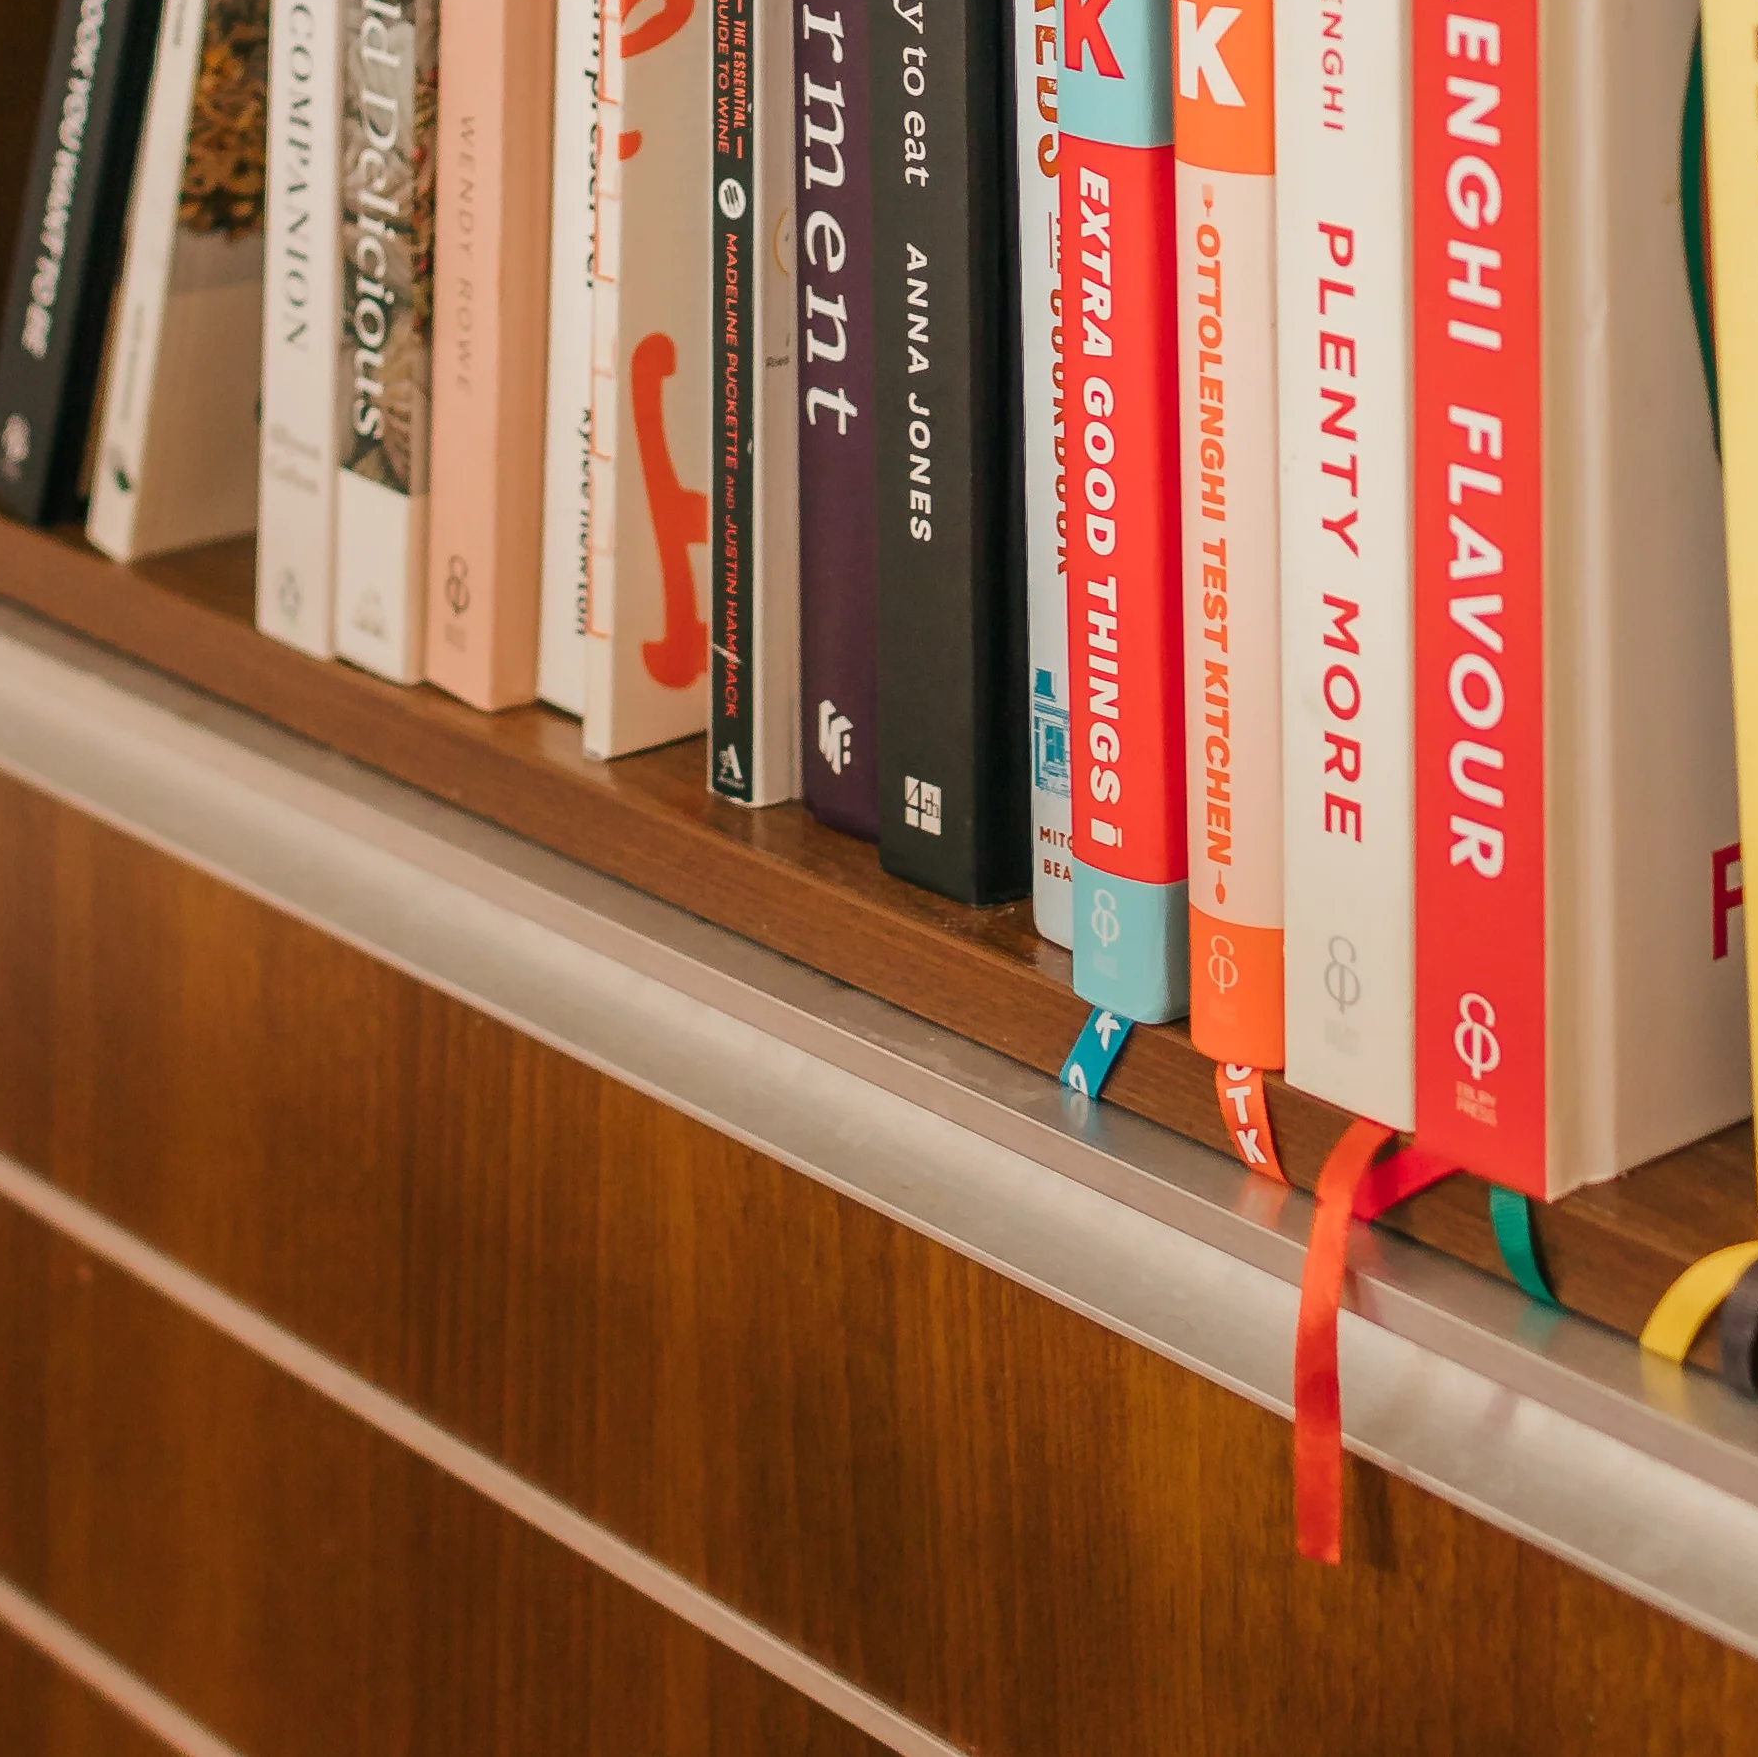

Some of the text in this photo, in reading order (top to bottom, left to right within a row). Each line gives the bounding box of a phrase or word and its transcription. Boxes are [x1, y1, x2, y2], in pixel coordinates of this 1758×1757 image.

[58, 76, 95, 152] YOU
[717, 61, 730, 90] TO
[717, 96, 730, 154] WINE
[733, 20, 747, 129] THE ESSENTIAL
[901, 40, 928, 96] to
[284, 0, 316, 350] COMPANION
[904, 104, 929, 189] eat
[352, 78, 401, 441] Delicious
[453, 114, 478, 397] WENDY ROWE
[726, 232, 740, 346] MADELINE
[725, 352, 740, 468] PUCKETTE
[906, 242, 932, 544] ANNA JONES
[1078, 166, 1121, 805] EXTRA GOOD THINGS
[1318, 220, 1363, 844] PLENTY MORE
[725, 515, 740, 594] JUSTIN
[1196, 223, 1233, 866] OTTOLENGHI TEST KITCHEN
[1448, 404, 1505, 879] FLAVOUR
